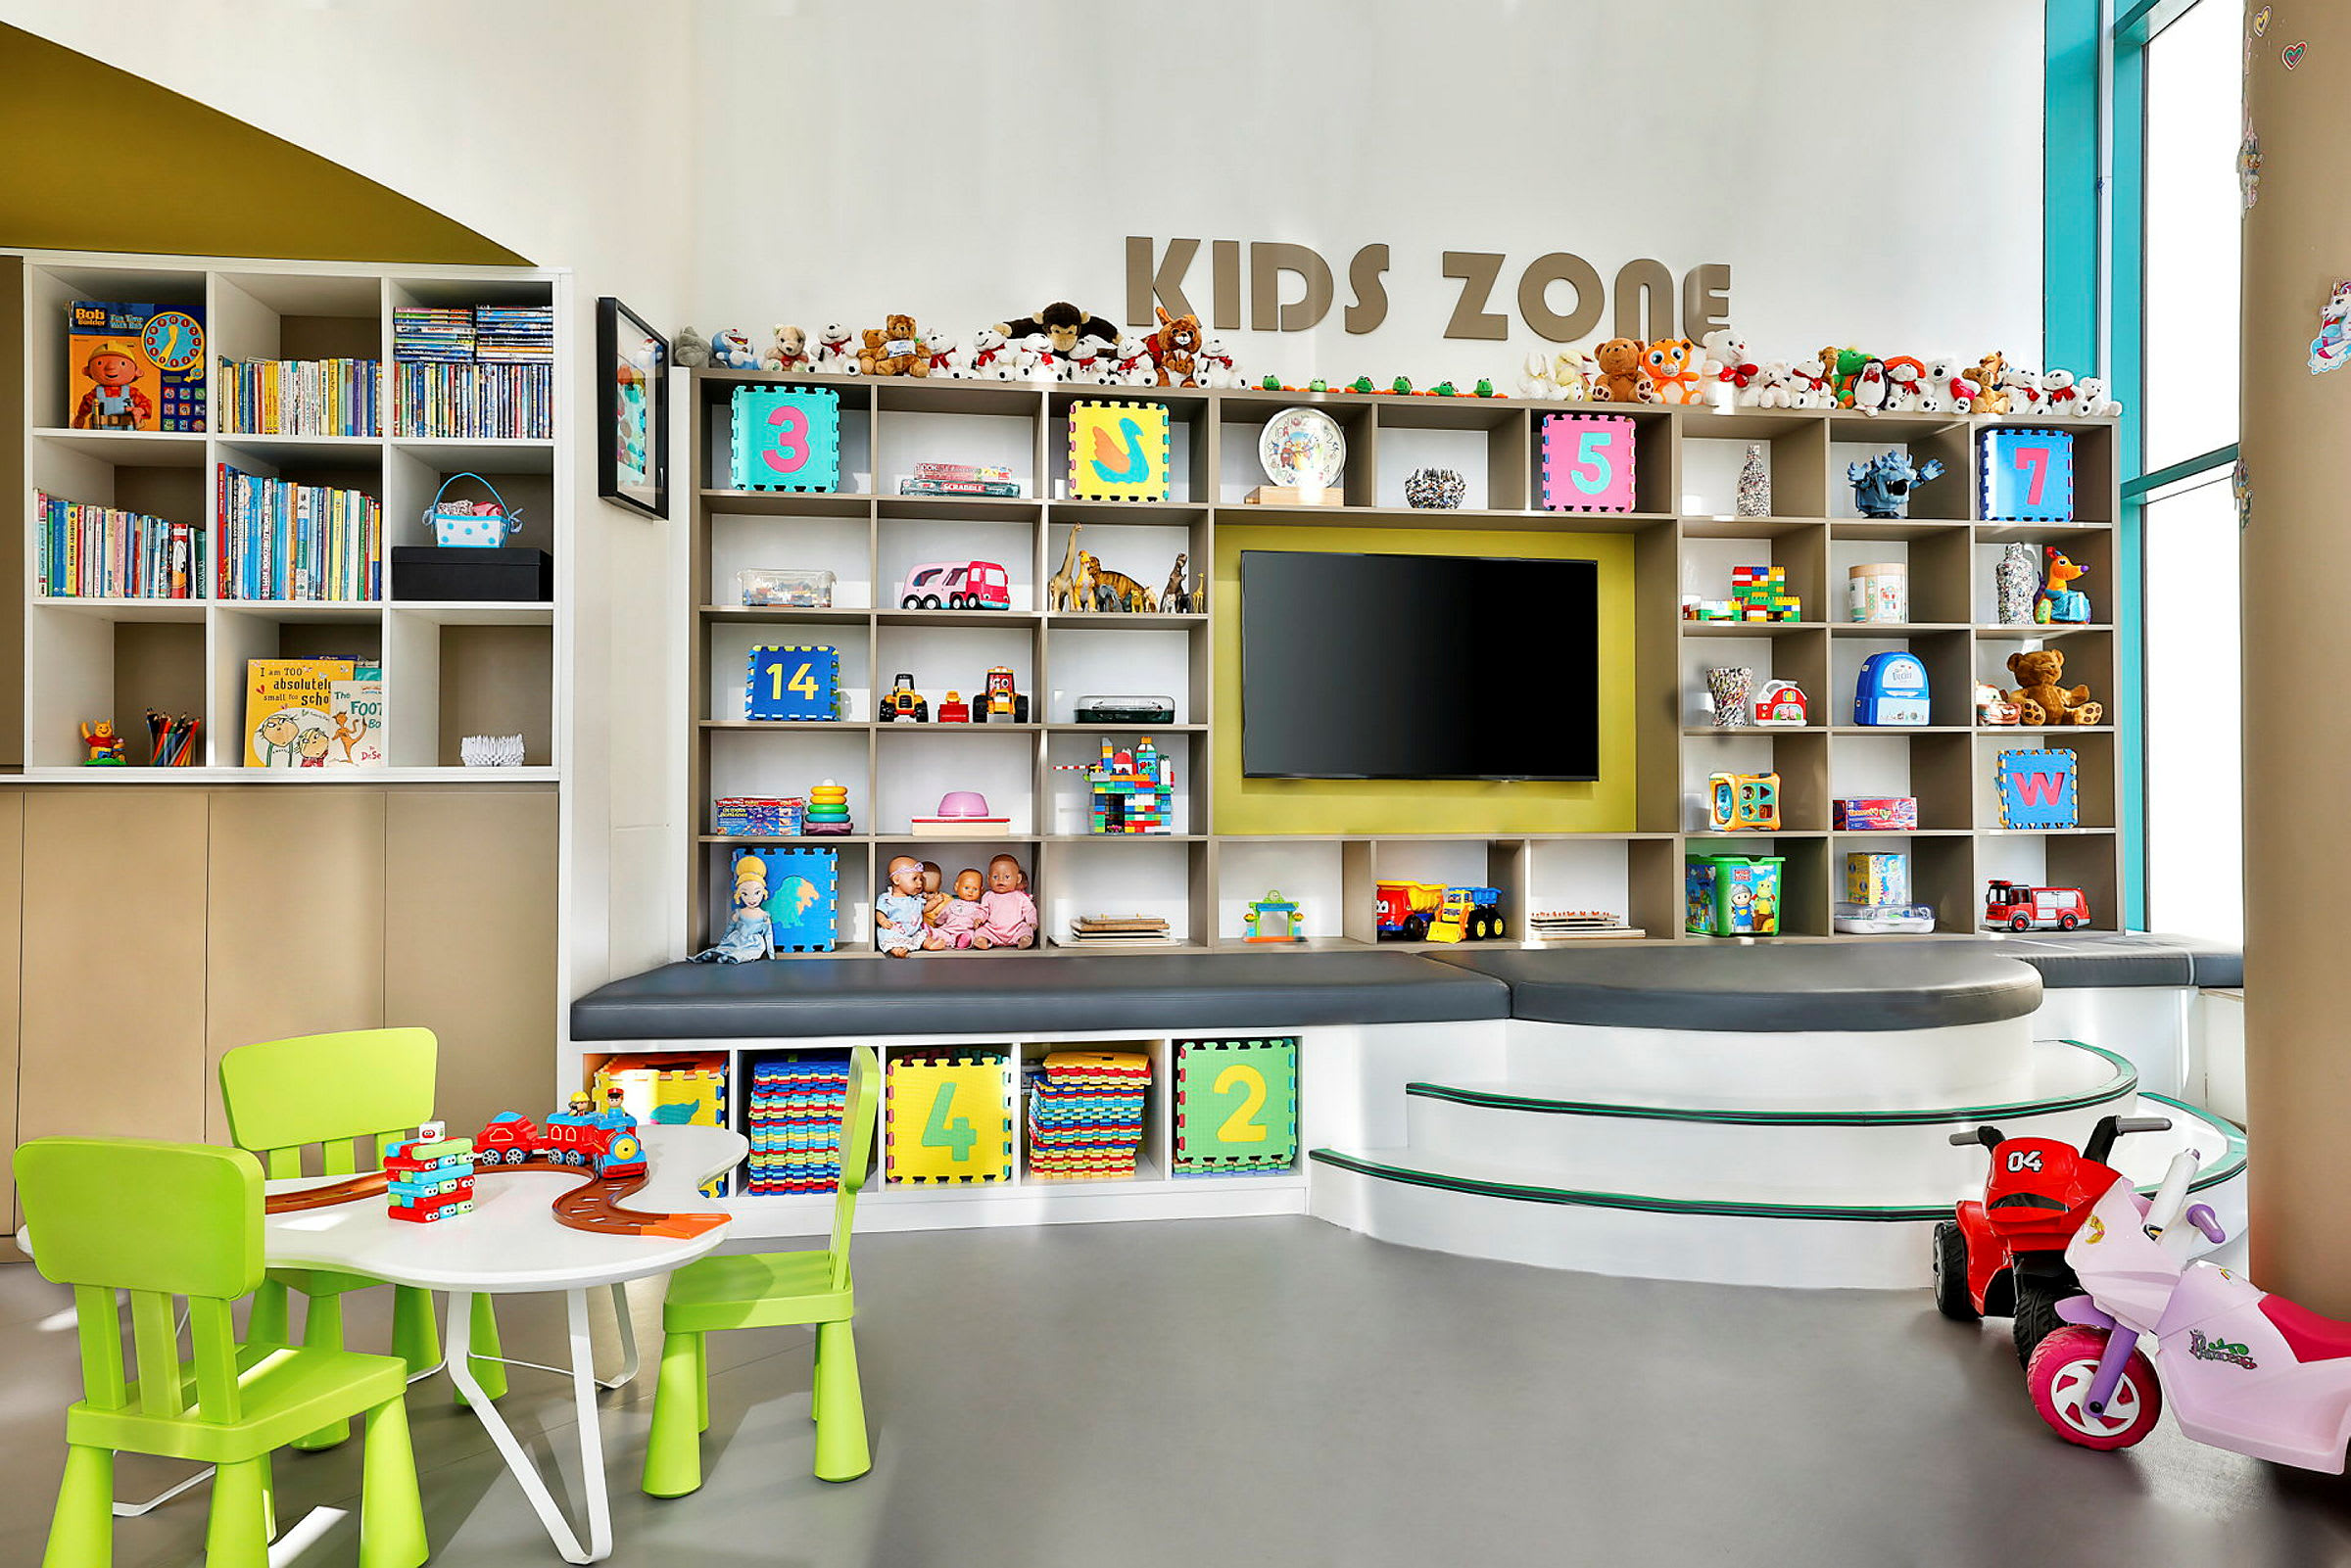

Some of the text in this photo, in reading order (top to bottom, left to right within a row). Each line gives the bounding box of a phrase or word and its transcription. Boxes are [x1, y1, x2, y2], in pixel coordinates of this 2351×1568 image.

[1126, 236, 1732, 349] KIDS ZONE
[75, 309, 105, 320] Bob
[762, 405, 810, 475] 3
[1570, 432, 1612, 496] 5
[2015, 448, 2049, 505] 7
[943, 483, 983, 492] SCRABBLE
[260, 667, 265, 677] I
[283, 667, 303, 676] TOO
[765, 662, 819, 701] 14
[301, 691, 329, 706] scho
[334, 690, 351, 699] The
[2010, 772, 2065, 807] W
[921, 1081, 978, 1163] 4
[1213, 1065, 1268, 1143] 2
[2006, 1150, 2043, 1173] 04
